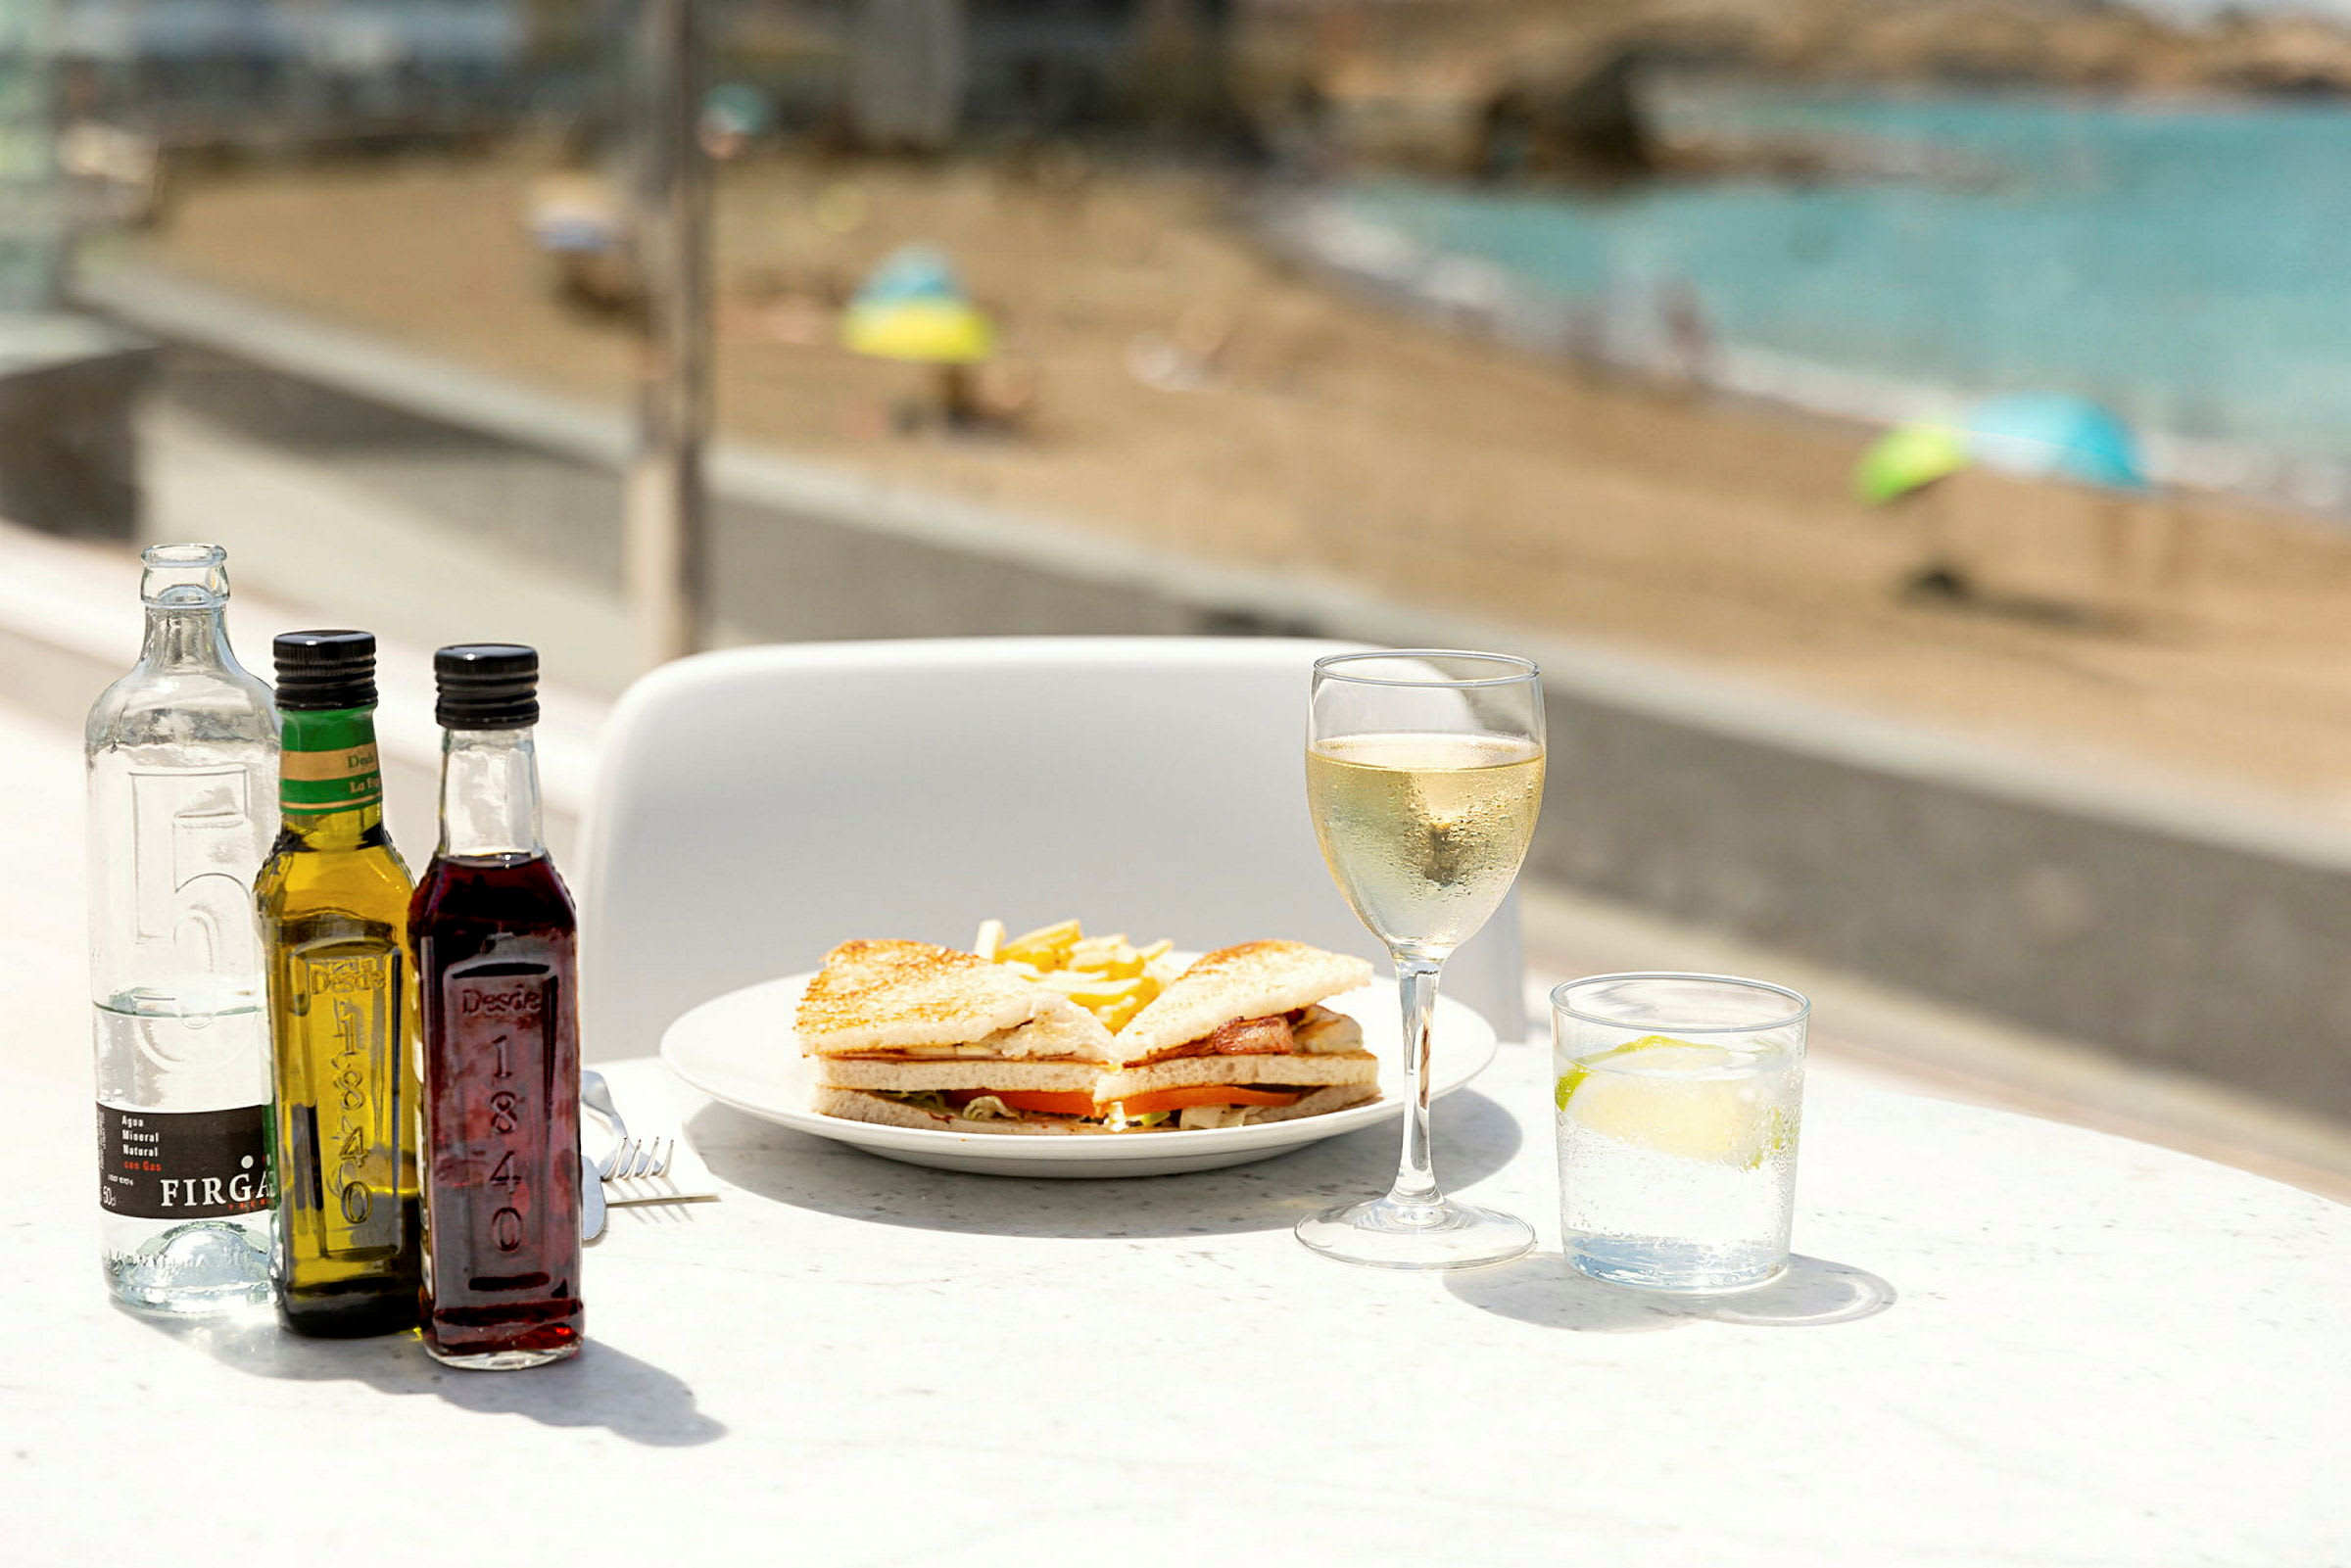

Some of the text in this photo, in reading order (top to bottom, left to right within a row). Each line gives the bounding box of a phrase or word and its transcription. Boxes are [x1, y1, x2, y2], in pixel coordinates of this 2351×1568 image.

[121, 1115, 144, 1128] Agua
[121, 1129, 160, 1143] Mineral
[490, 1034, 522, 1252] 1840
[122, 1144, 159, 1157] Natural
